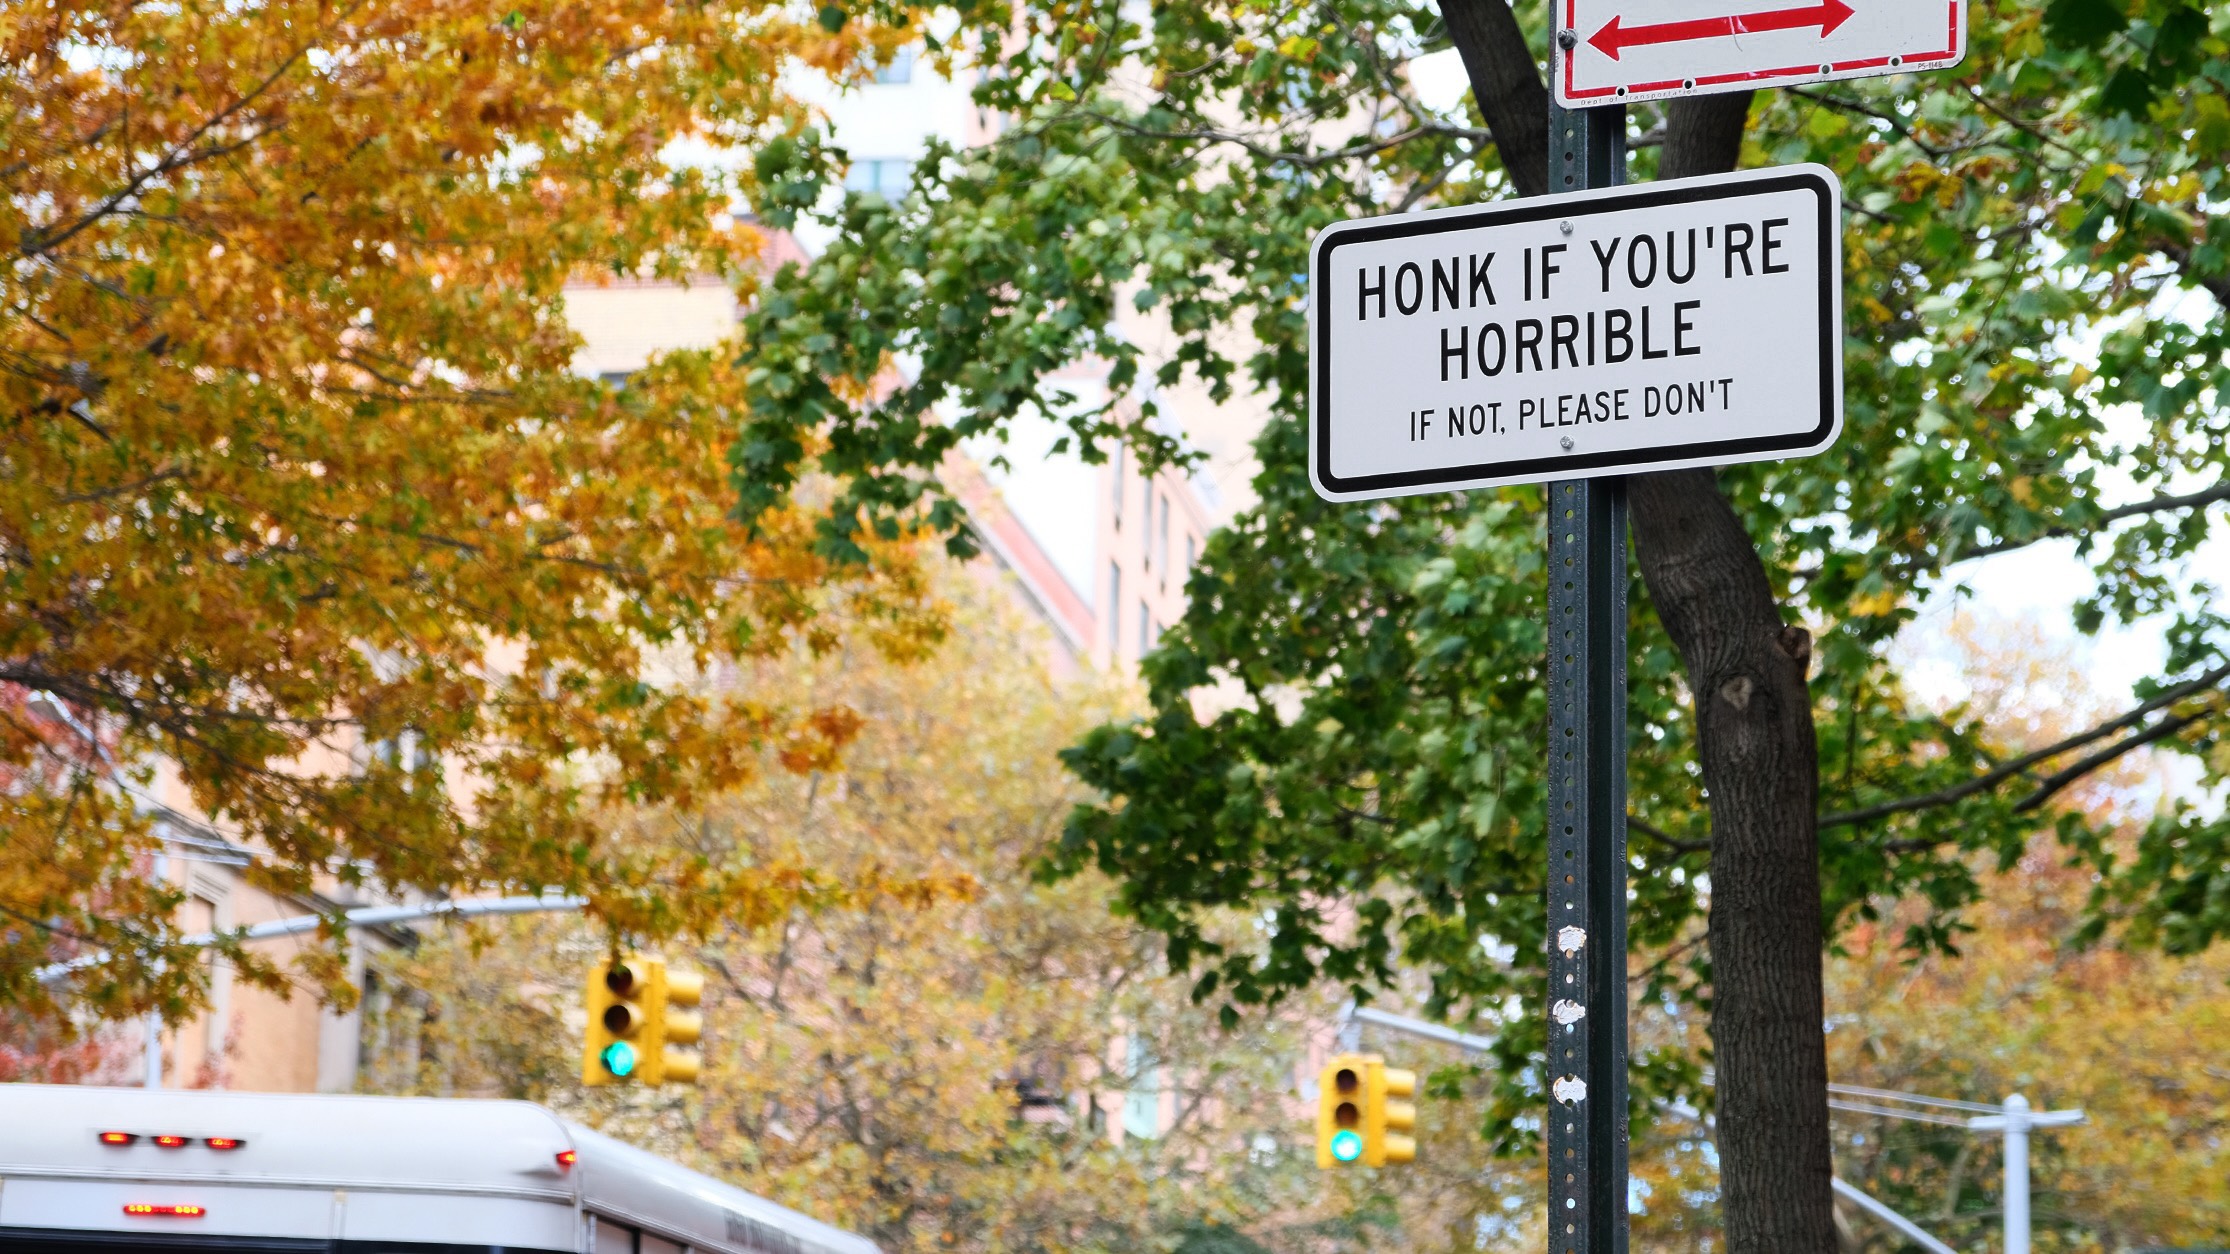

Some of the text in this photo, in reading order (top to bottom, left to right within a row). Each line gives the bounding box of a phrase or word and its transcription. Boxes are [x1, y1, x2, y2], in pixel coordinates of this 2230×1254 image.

[1625, 88, 1698, 101] Transportation
[1358, 217, 1789, 321] HONK IF YOU'RE
[1440, 299, 1701, 382] HORRIBLE
[1410, 378, 1734, 442] IF NOT, PLEASE DON'T
